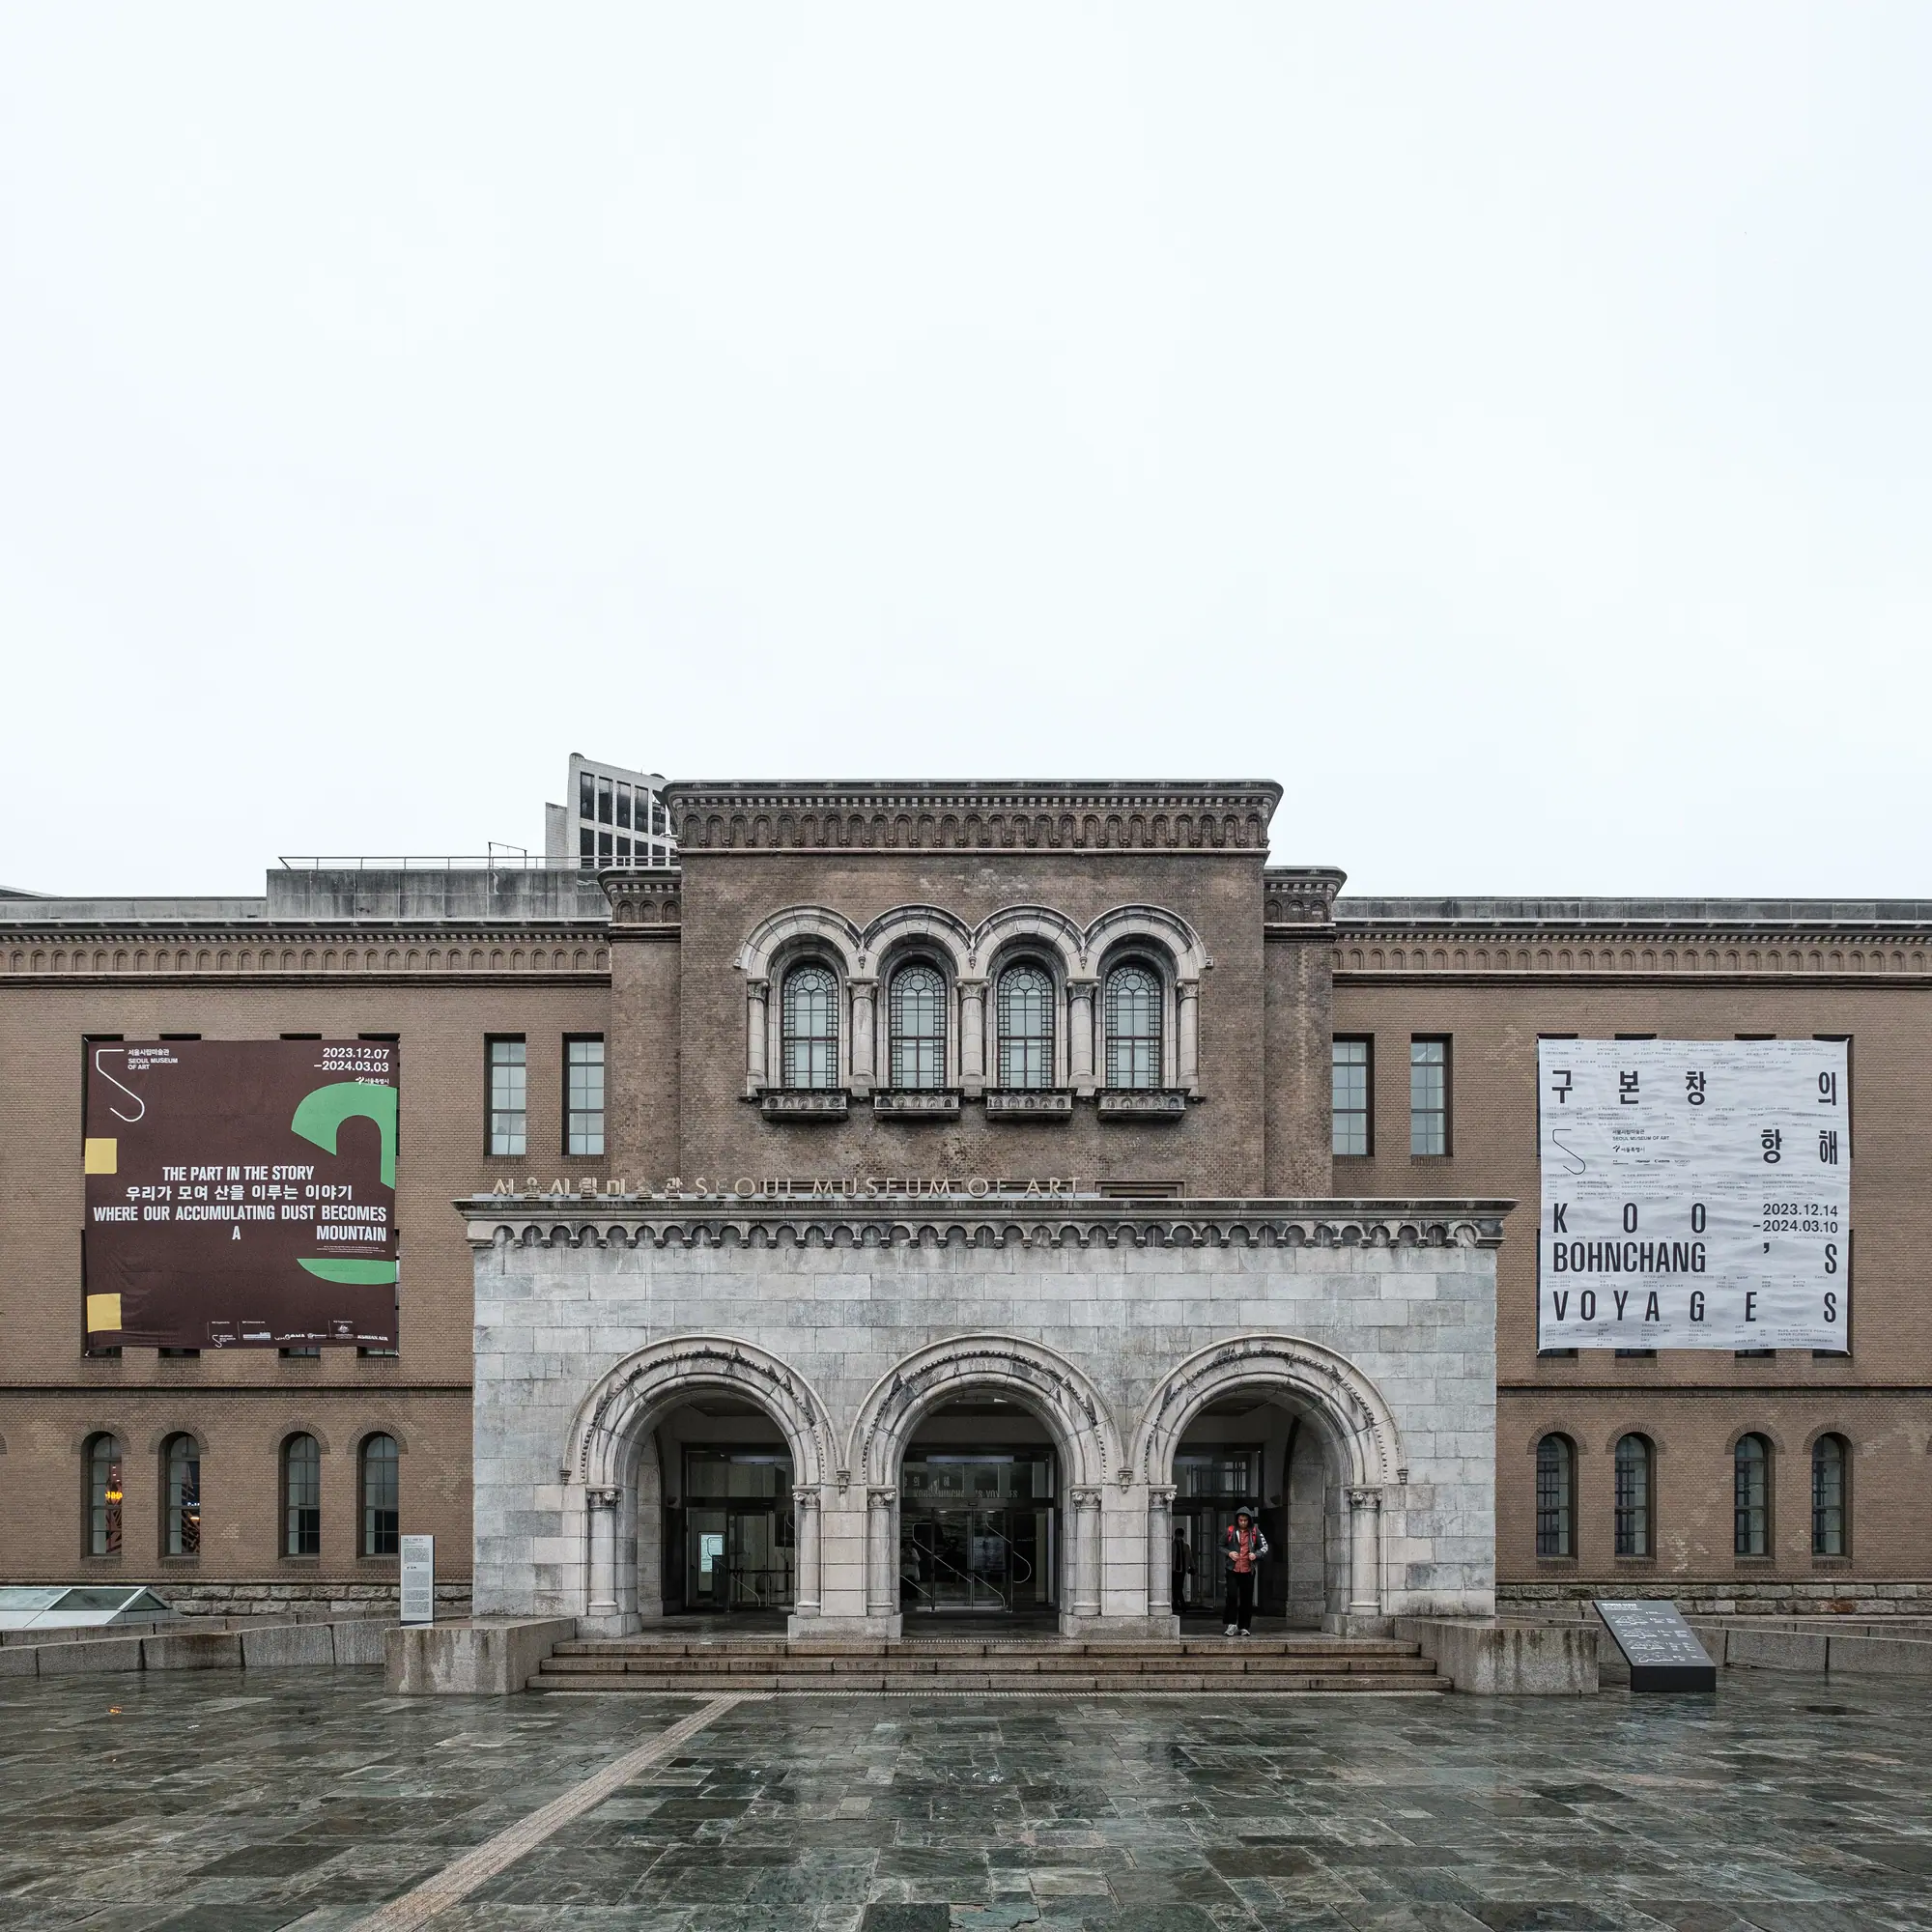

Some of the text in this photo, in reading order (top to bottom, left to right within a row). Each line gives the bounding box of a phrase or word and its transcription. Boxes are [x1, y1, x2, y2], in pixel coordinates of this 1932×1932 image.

[323, 1047, 390, 1060] 2023.12.07
[162, 1165, 315, 1181] THE PART IN THE STORY
[125, 1184, 353, 1201] 우리가 모여 산을 이루는 이야기
[695, 1176, 1081, 1199] SEOUL MUSEUM OF ART
[93, 1205, 386, 1222] WHERE OUR ACCUMULATING DUST BECOMES
[1763, 1203, 1838, 1217] 2023.12.14
[232, 1225, 386, 1241] A MOUNTAIN
